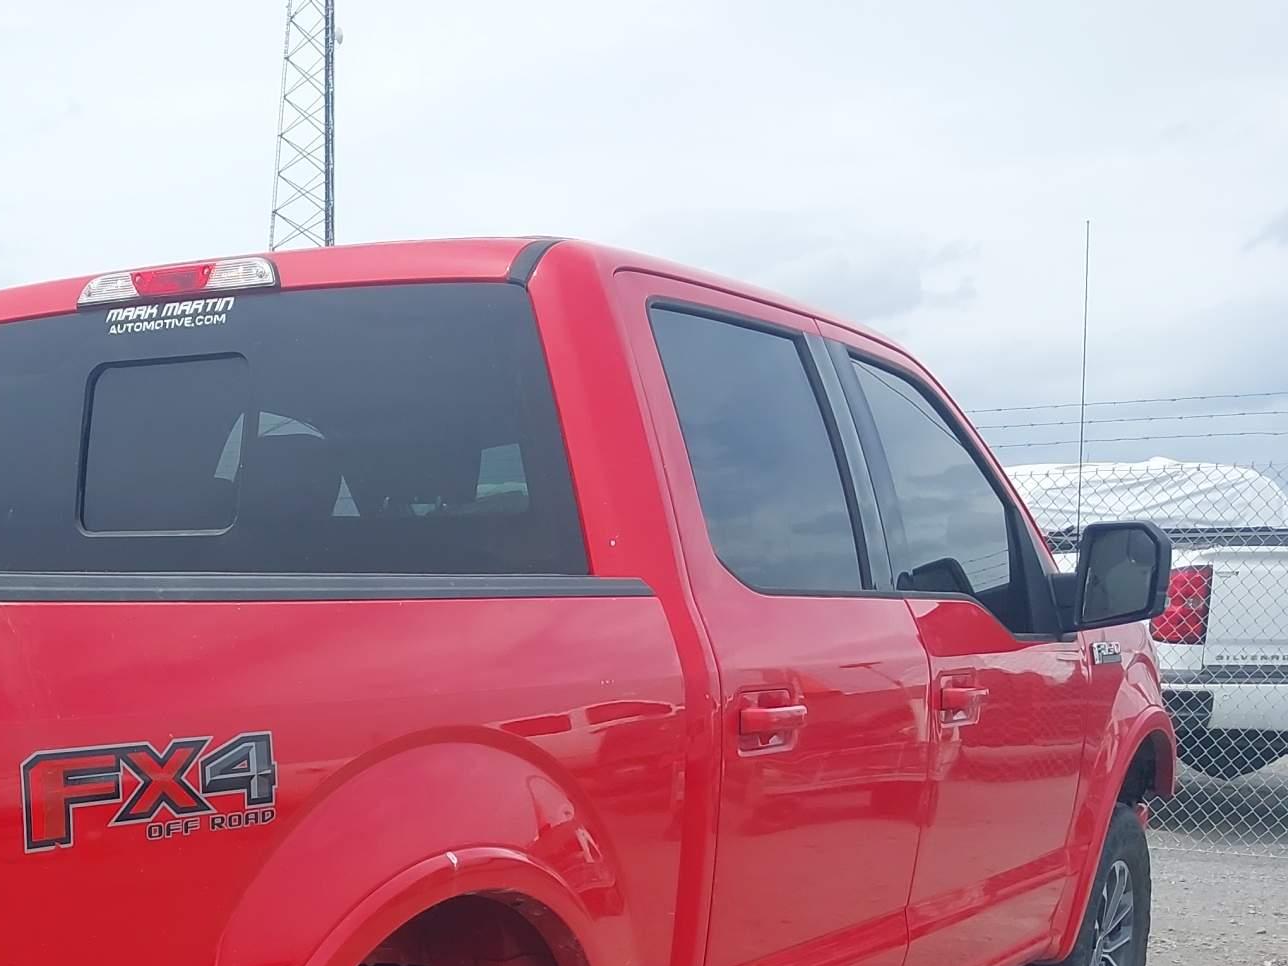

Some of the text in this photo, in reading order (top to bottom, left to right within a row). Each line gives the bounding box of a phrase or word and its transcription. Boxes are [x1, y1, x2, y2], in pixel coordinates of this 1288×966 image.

[105, 297, 235, 323] MARK MARTIN
[108, 314, 226, 335] AUTOMOTIVE.COM
[20, 731, 278, 853] FX4
[146, 808, 276, 840] OFF ROAD
